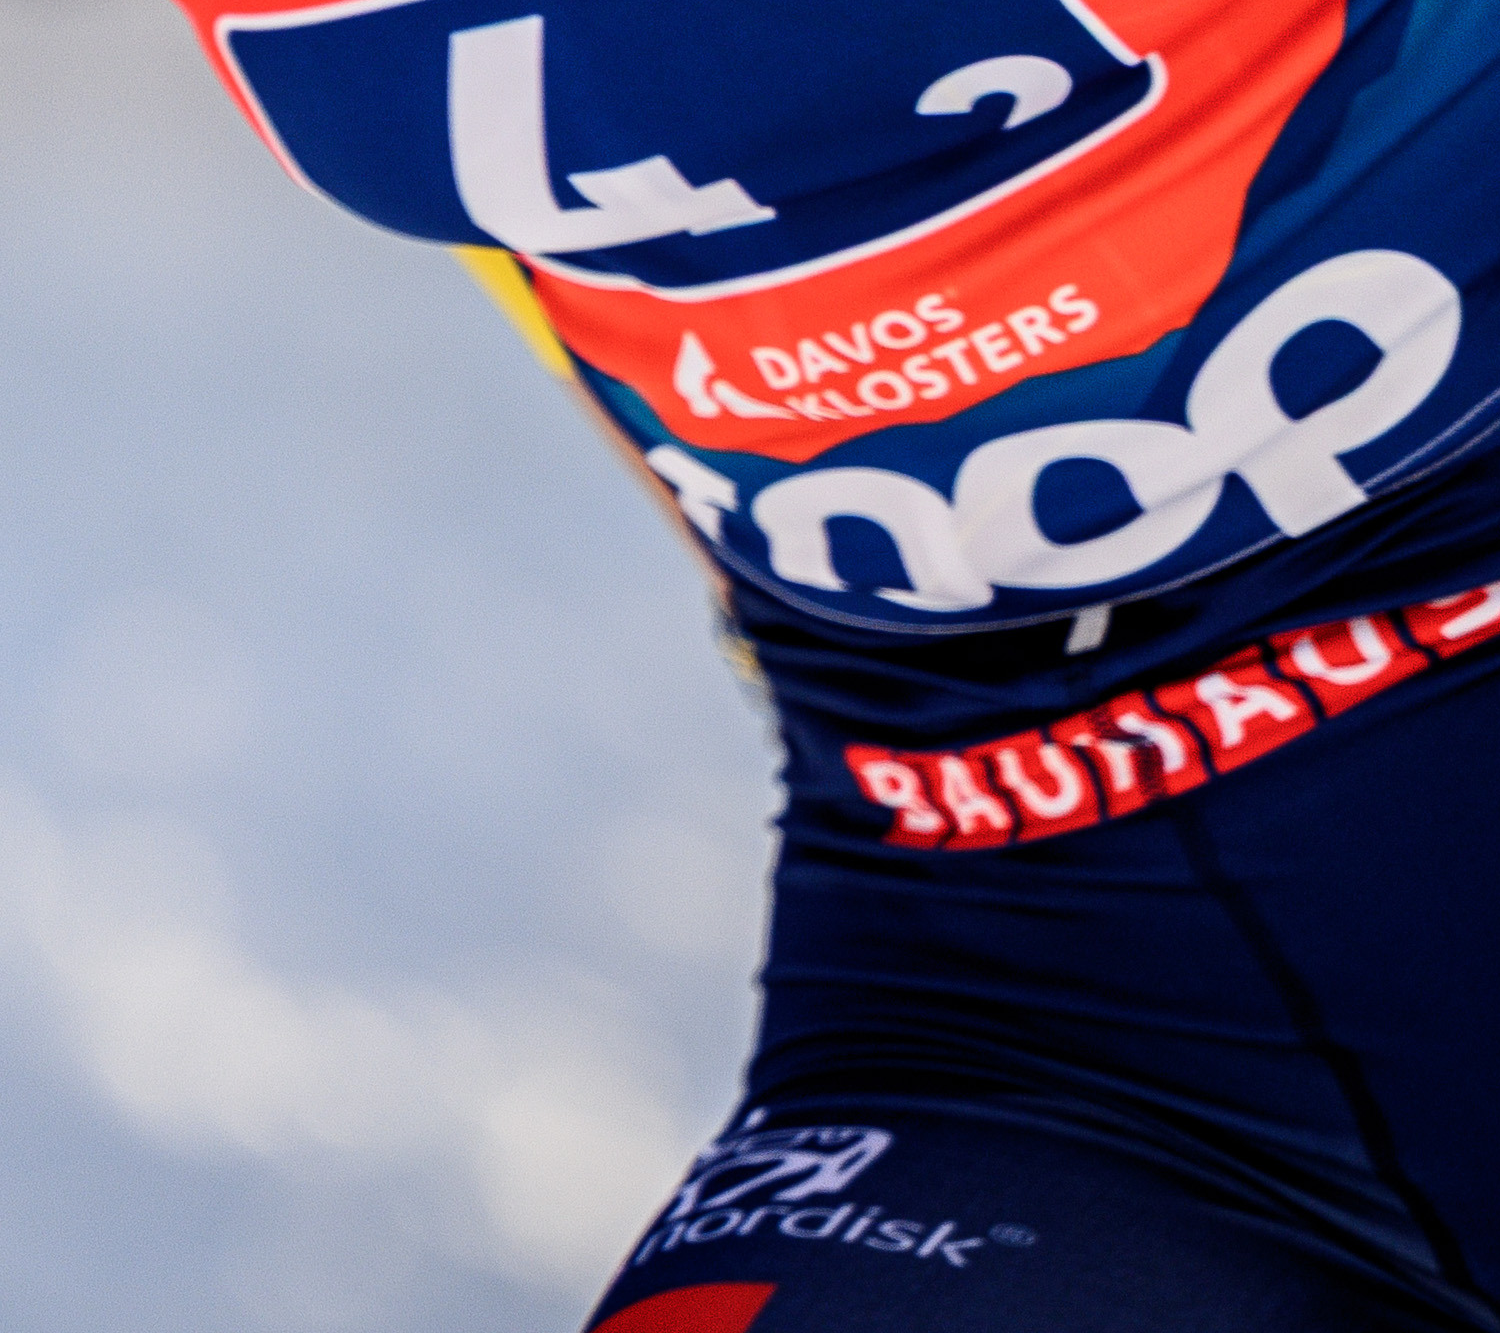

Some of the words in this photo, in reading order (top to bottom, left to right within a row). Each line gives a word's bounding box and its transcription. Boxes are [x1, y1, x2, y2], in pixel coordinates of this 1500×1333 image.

[448, 14, 777, 255] 4
[750, 292, 965, 391] DAVOS
[785, 283, 1099, 421] KLOSTERS
[633, 1201, 988, 1268] nordisk
